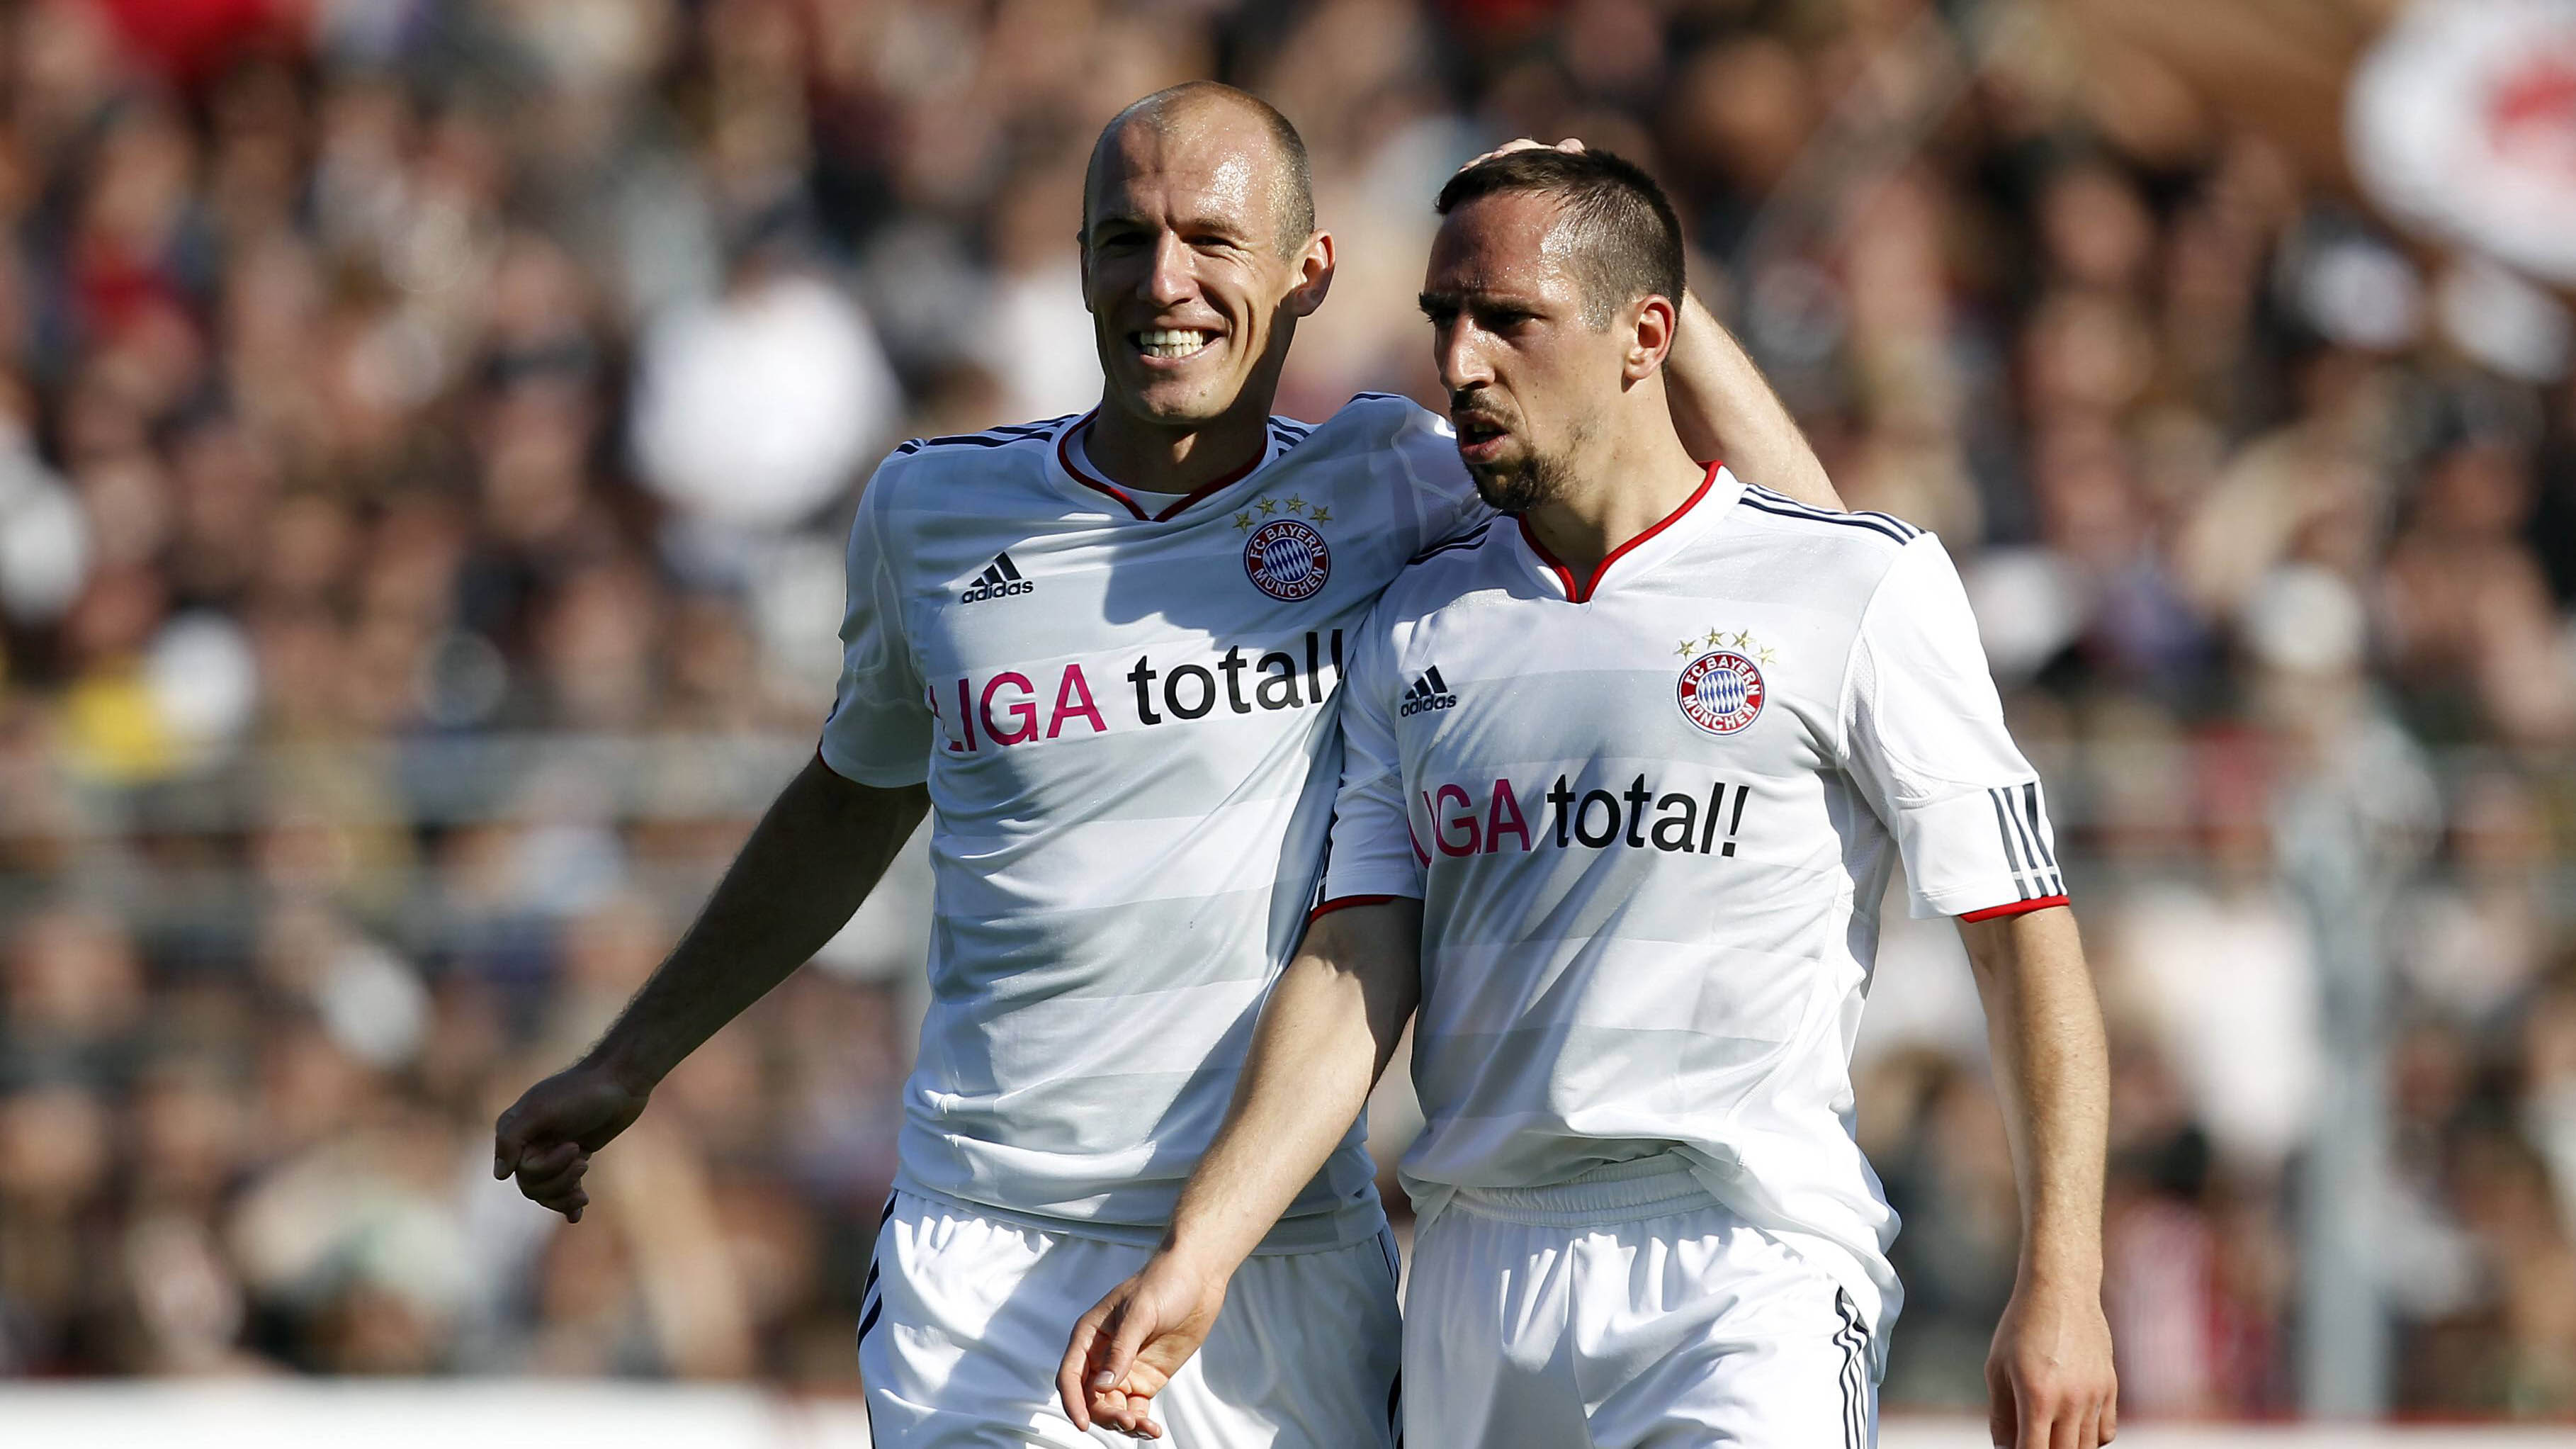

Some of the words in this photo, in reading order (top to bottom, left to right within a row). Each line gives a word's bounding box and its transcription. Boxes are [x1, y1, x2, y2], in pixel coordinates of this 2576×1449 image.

[1250, 539, 1266, 559] FC
[1265, 525, 1325, 558] BAYERN
[961, 580, 1034, 604] adidas
[1684, 665, 1705, 686] FC
[1705, 656, 1761, 696] BAYERN
[1401, 694, 1457, 717] adidas
[1547, 773, 1750, 857] total!
